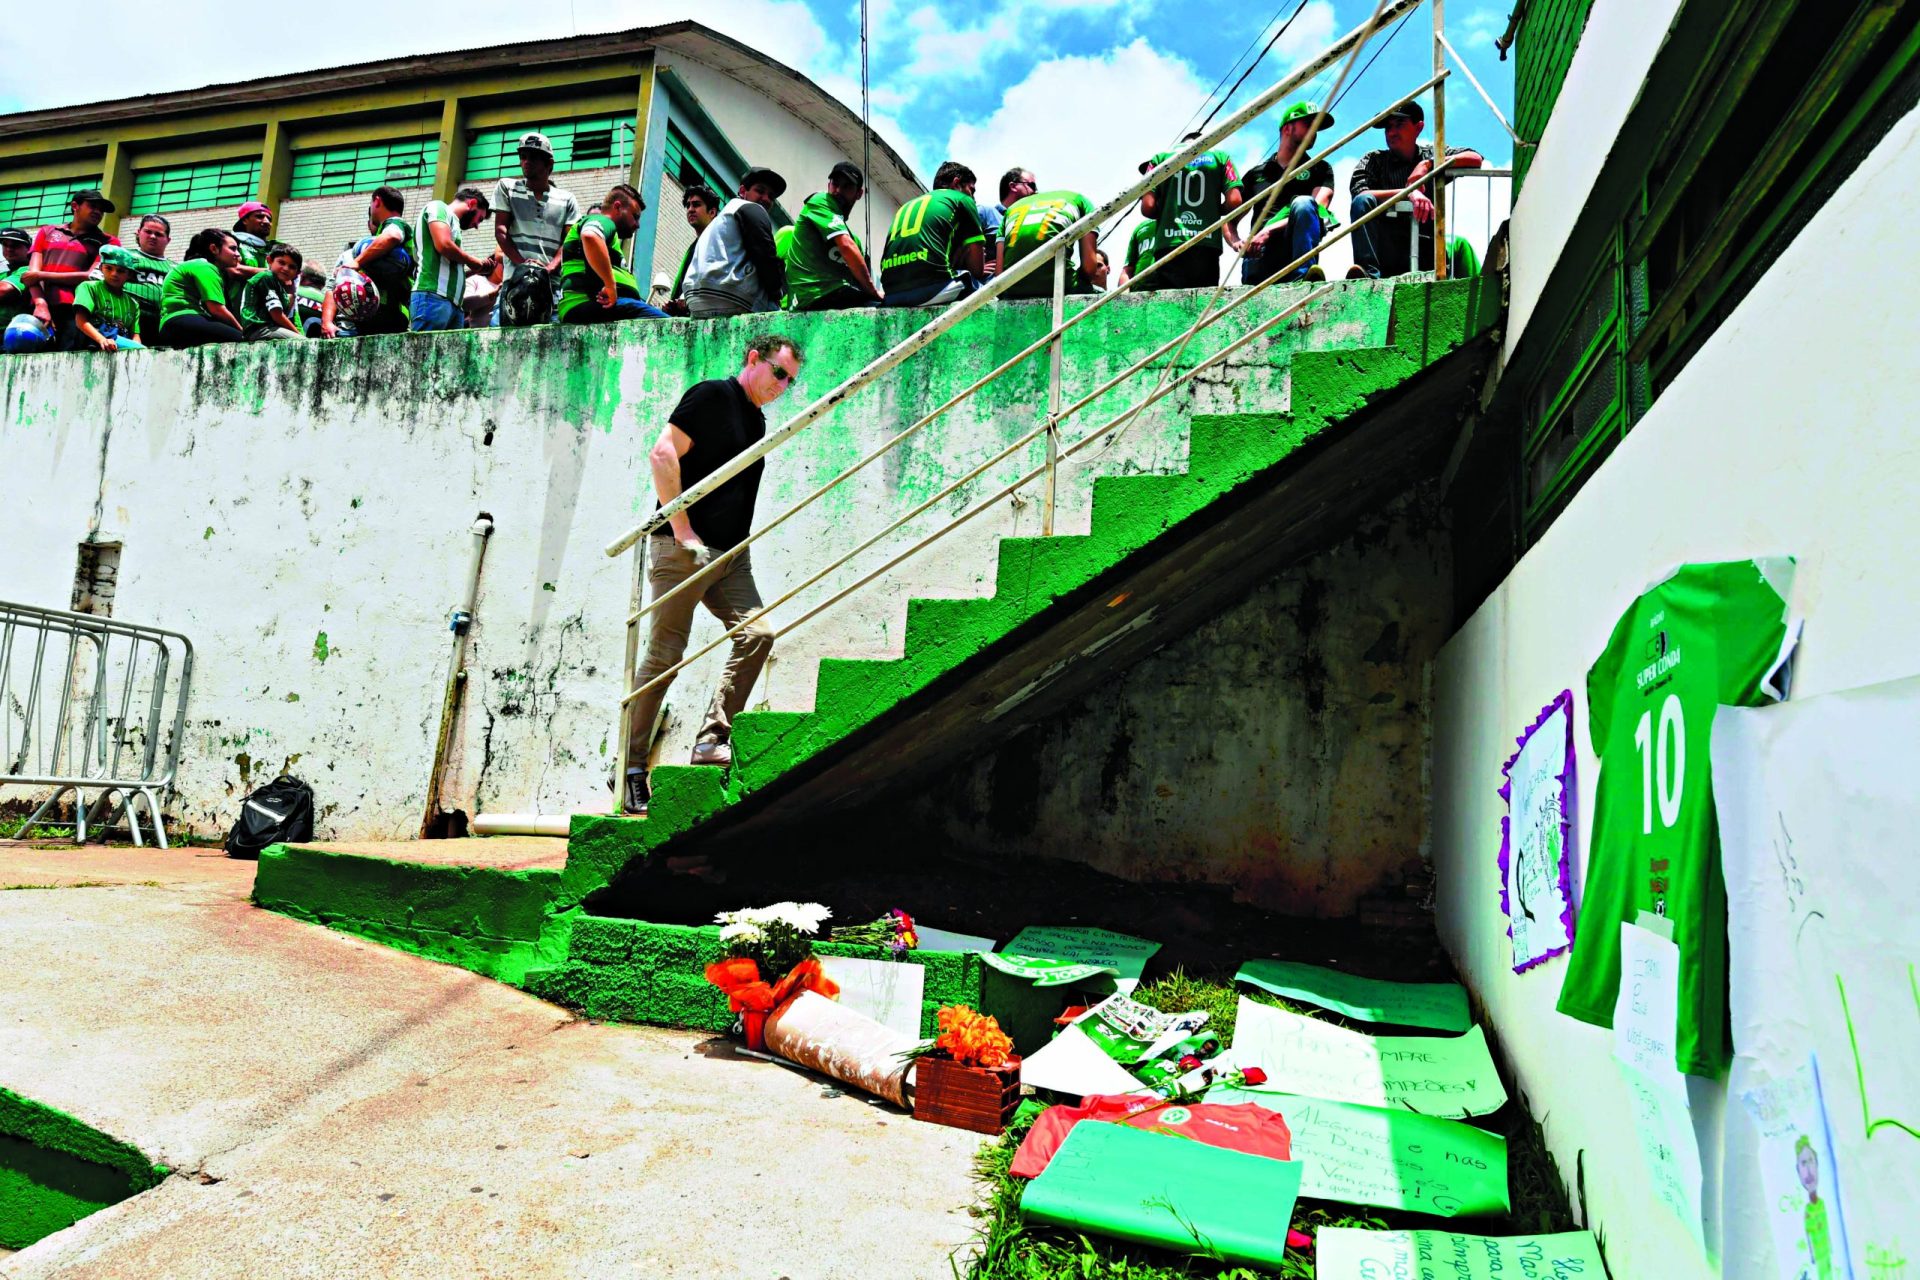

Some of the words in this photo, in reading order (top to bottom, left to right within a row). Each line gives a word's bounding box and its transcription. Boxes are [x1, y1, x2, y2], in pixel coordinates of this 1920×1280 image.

[1174, 170, 1205, 207] 10
[890, 194, 932, 241] 10
[1174, 217, 1202, 226] aurora
[1164, 228, 1212, 239] Unim
[136, 271, 164, 285] CAI
[1636, 662, 1657, 690] SUPER
[1634, 693, 1686, 835] 10
[1342, 1037, 1439, 1064] SMPRE
[1445, 1150, 1488, 1170] nas
[1472, 1238, 1504, 1273] para
[1517, 1241, 1544, 1278] Mas
